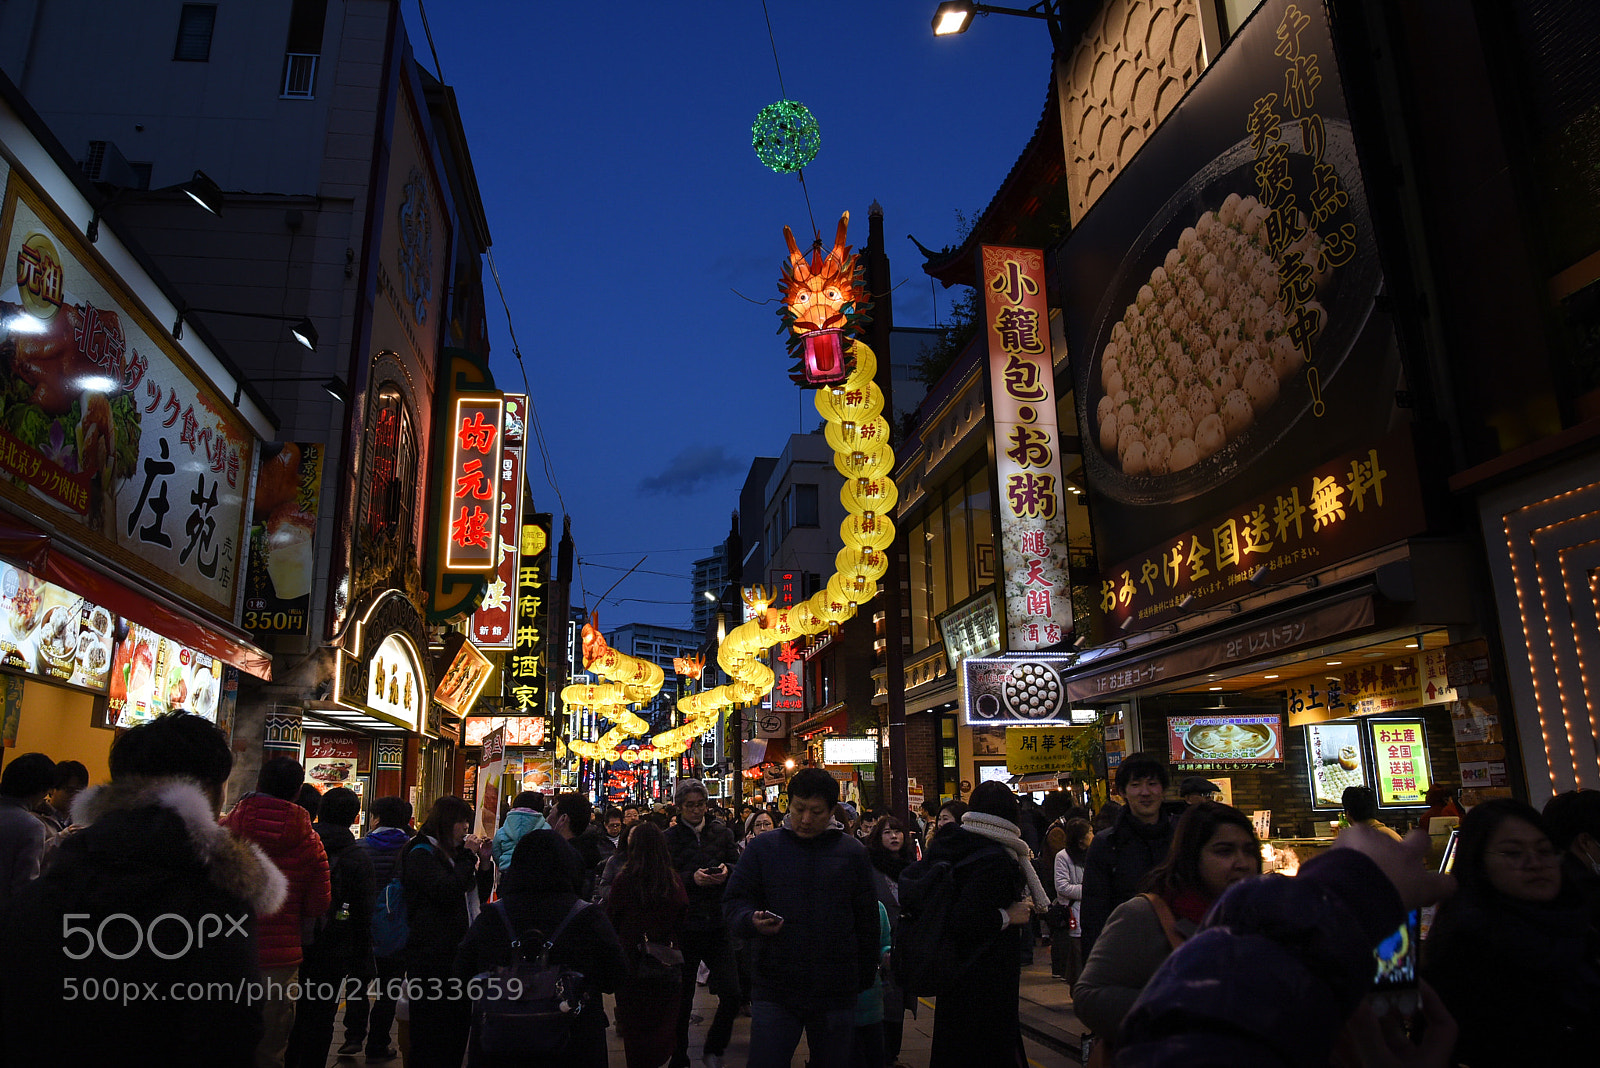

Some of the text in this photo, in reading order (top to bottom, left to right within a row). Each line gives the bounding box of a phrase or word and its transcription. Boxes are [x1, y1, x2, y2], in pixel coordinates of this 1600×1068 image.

[1274, 3, 1358, 275] 手作り点心
[16, 242, 65, 306] 元祖
[74, 301, 239, 490] 北京ダック食べ歩き
[299, 446, 318, 513] 北京ダック
[1099, 448, 1388, 615] おみやげ全国送料無料
[218, 535, 234, 590] 売店
[249, 600, 265, 609] 1枚
[243, 611, 303, 630] 350円
[478, 625, 502, 636] 新館
[512, 566, 542, 710] 王府井酒家
[1022, 624, 1062, 644] 酒家
[1226, 621, 1306, 658] 2F レストラン
[1096, 665, 1164, 692] 1F お土産コーナー
[1289, 656, 1418, 715] お土産 送料無料
[1437, 686, 1452, 696] 店内
[1379, 728, 1416, 743] お土産
[311, 747, 353, 757] ダックフェア
[1387, 744, 1412, 759] 全国
[1389, 760, 1415, 775] 送料
[1391, 777, 1416, 792] 無料
